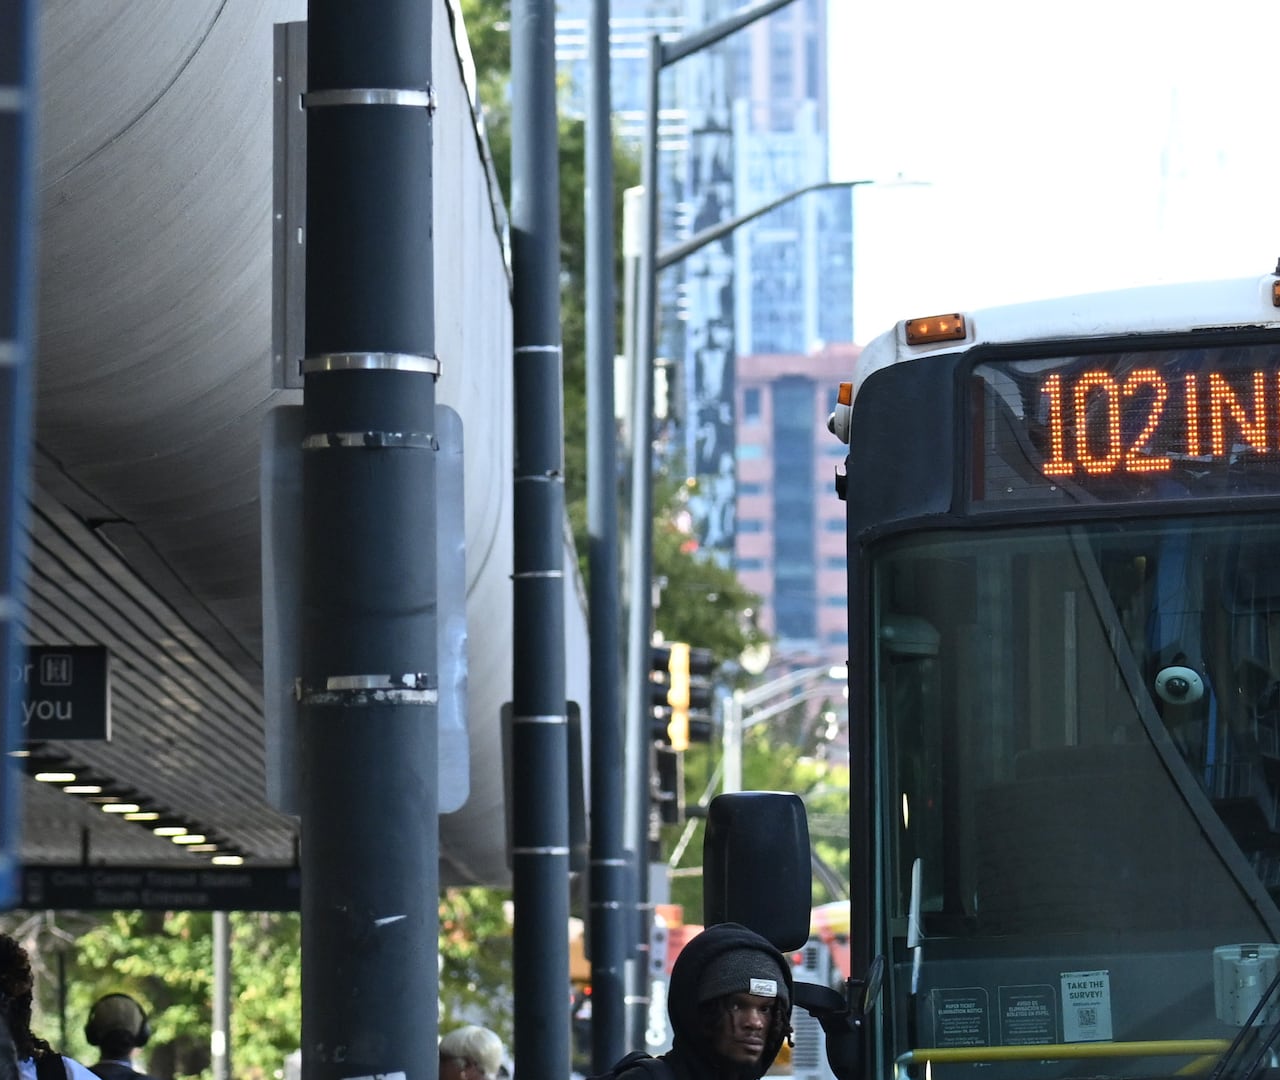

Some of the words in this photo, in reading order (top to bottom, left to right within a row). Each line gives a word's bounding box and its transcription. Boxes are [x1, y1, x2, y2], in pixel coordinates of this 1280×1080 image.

[1040, 368, 1170, 476] 102
[21, 700, 72, 727] you
[1067, 982, 1088, 990] TAKE
[1069, 991, 1103, 999] SURVEY!
